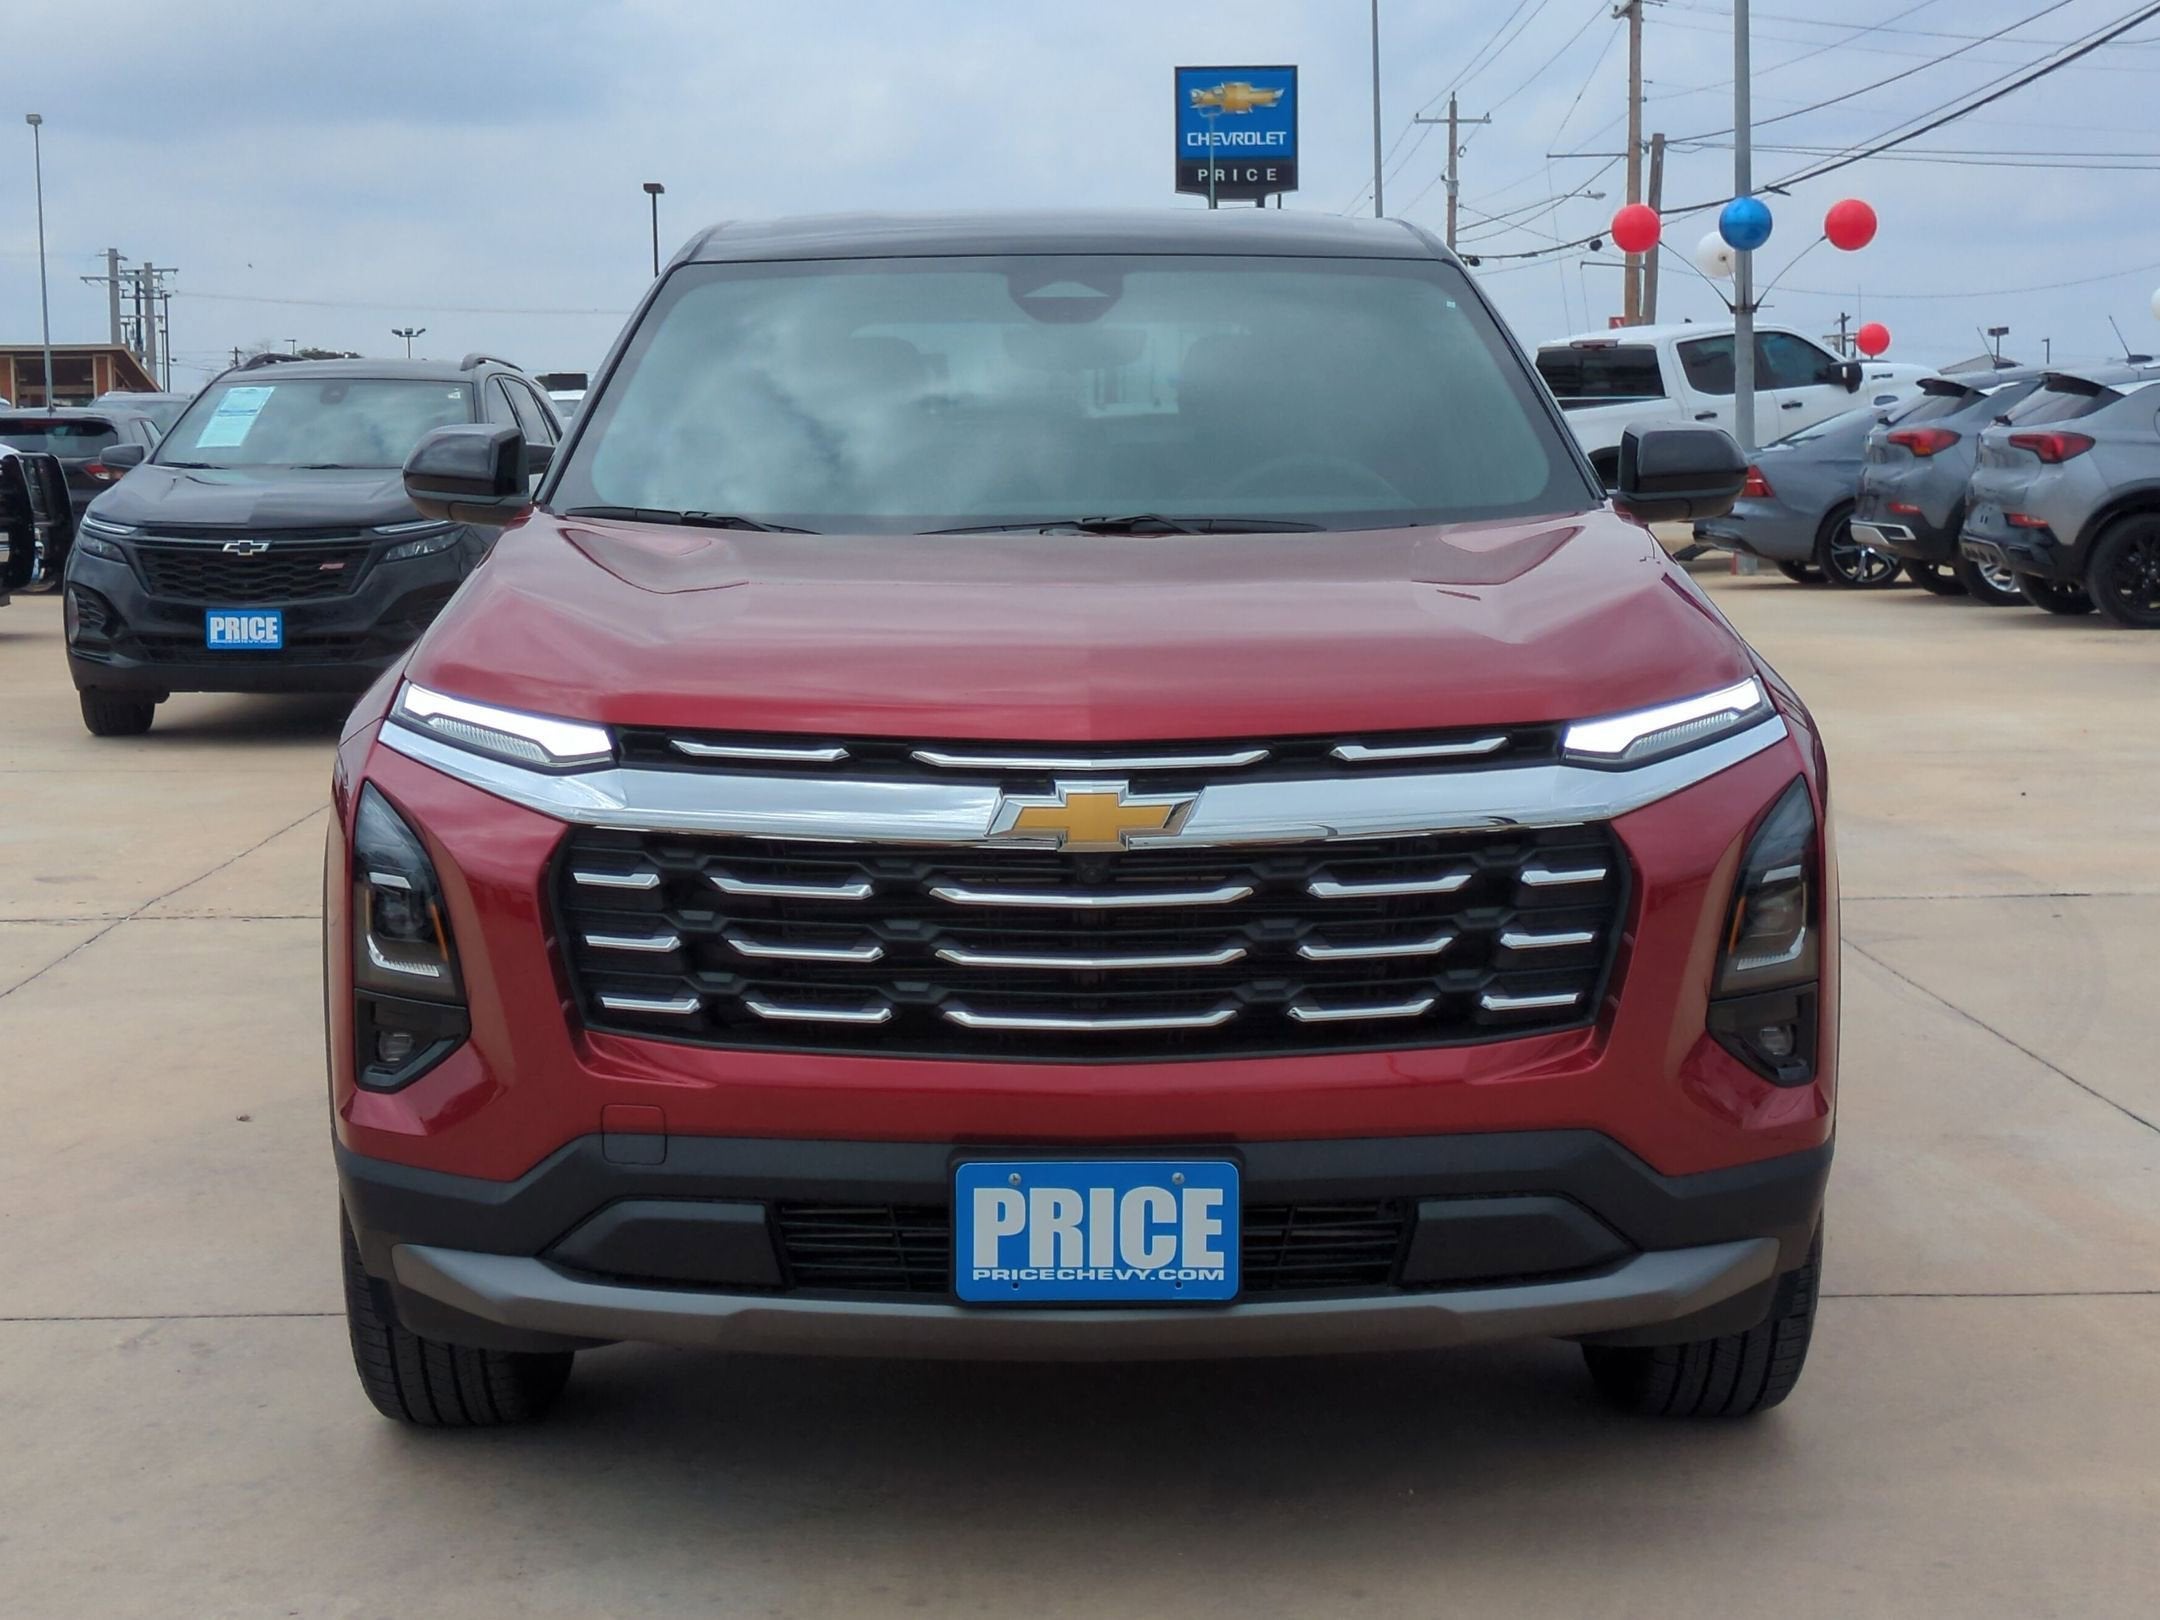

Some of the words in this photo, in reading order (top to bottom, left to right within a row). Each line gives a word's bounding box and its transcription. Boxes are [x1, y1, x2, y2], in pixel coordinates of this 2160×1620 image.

[1187, 131, 1286, 146] CHEVROLET
[1198, 168, 1277, 182] PRICE
[209, 616, 278, 640] PRICE
[973, 1186, 1224, 1269] PRICE
[973, 1269, 1225, 1281] PRICECHEVY.COM
